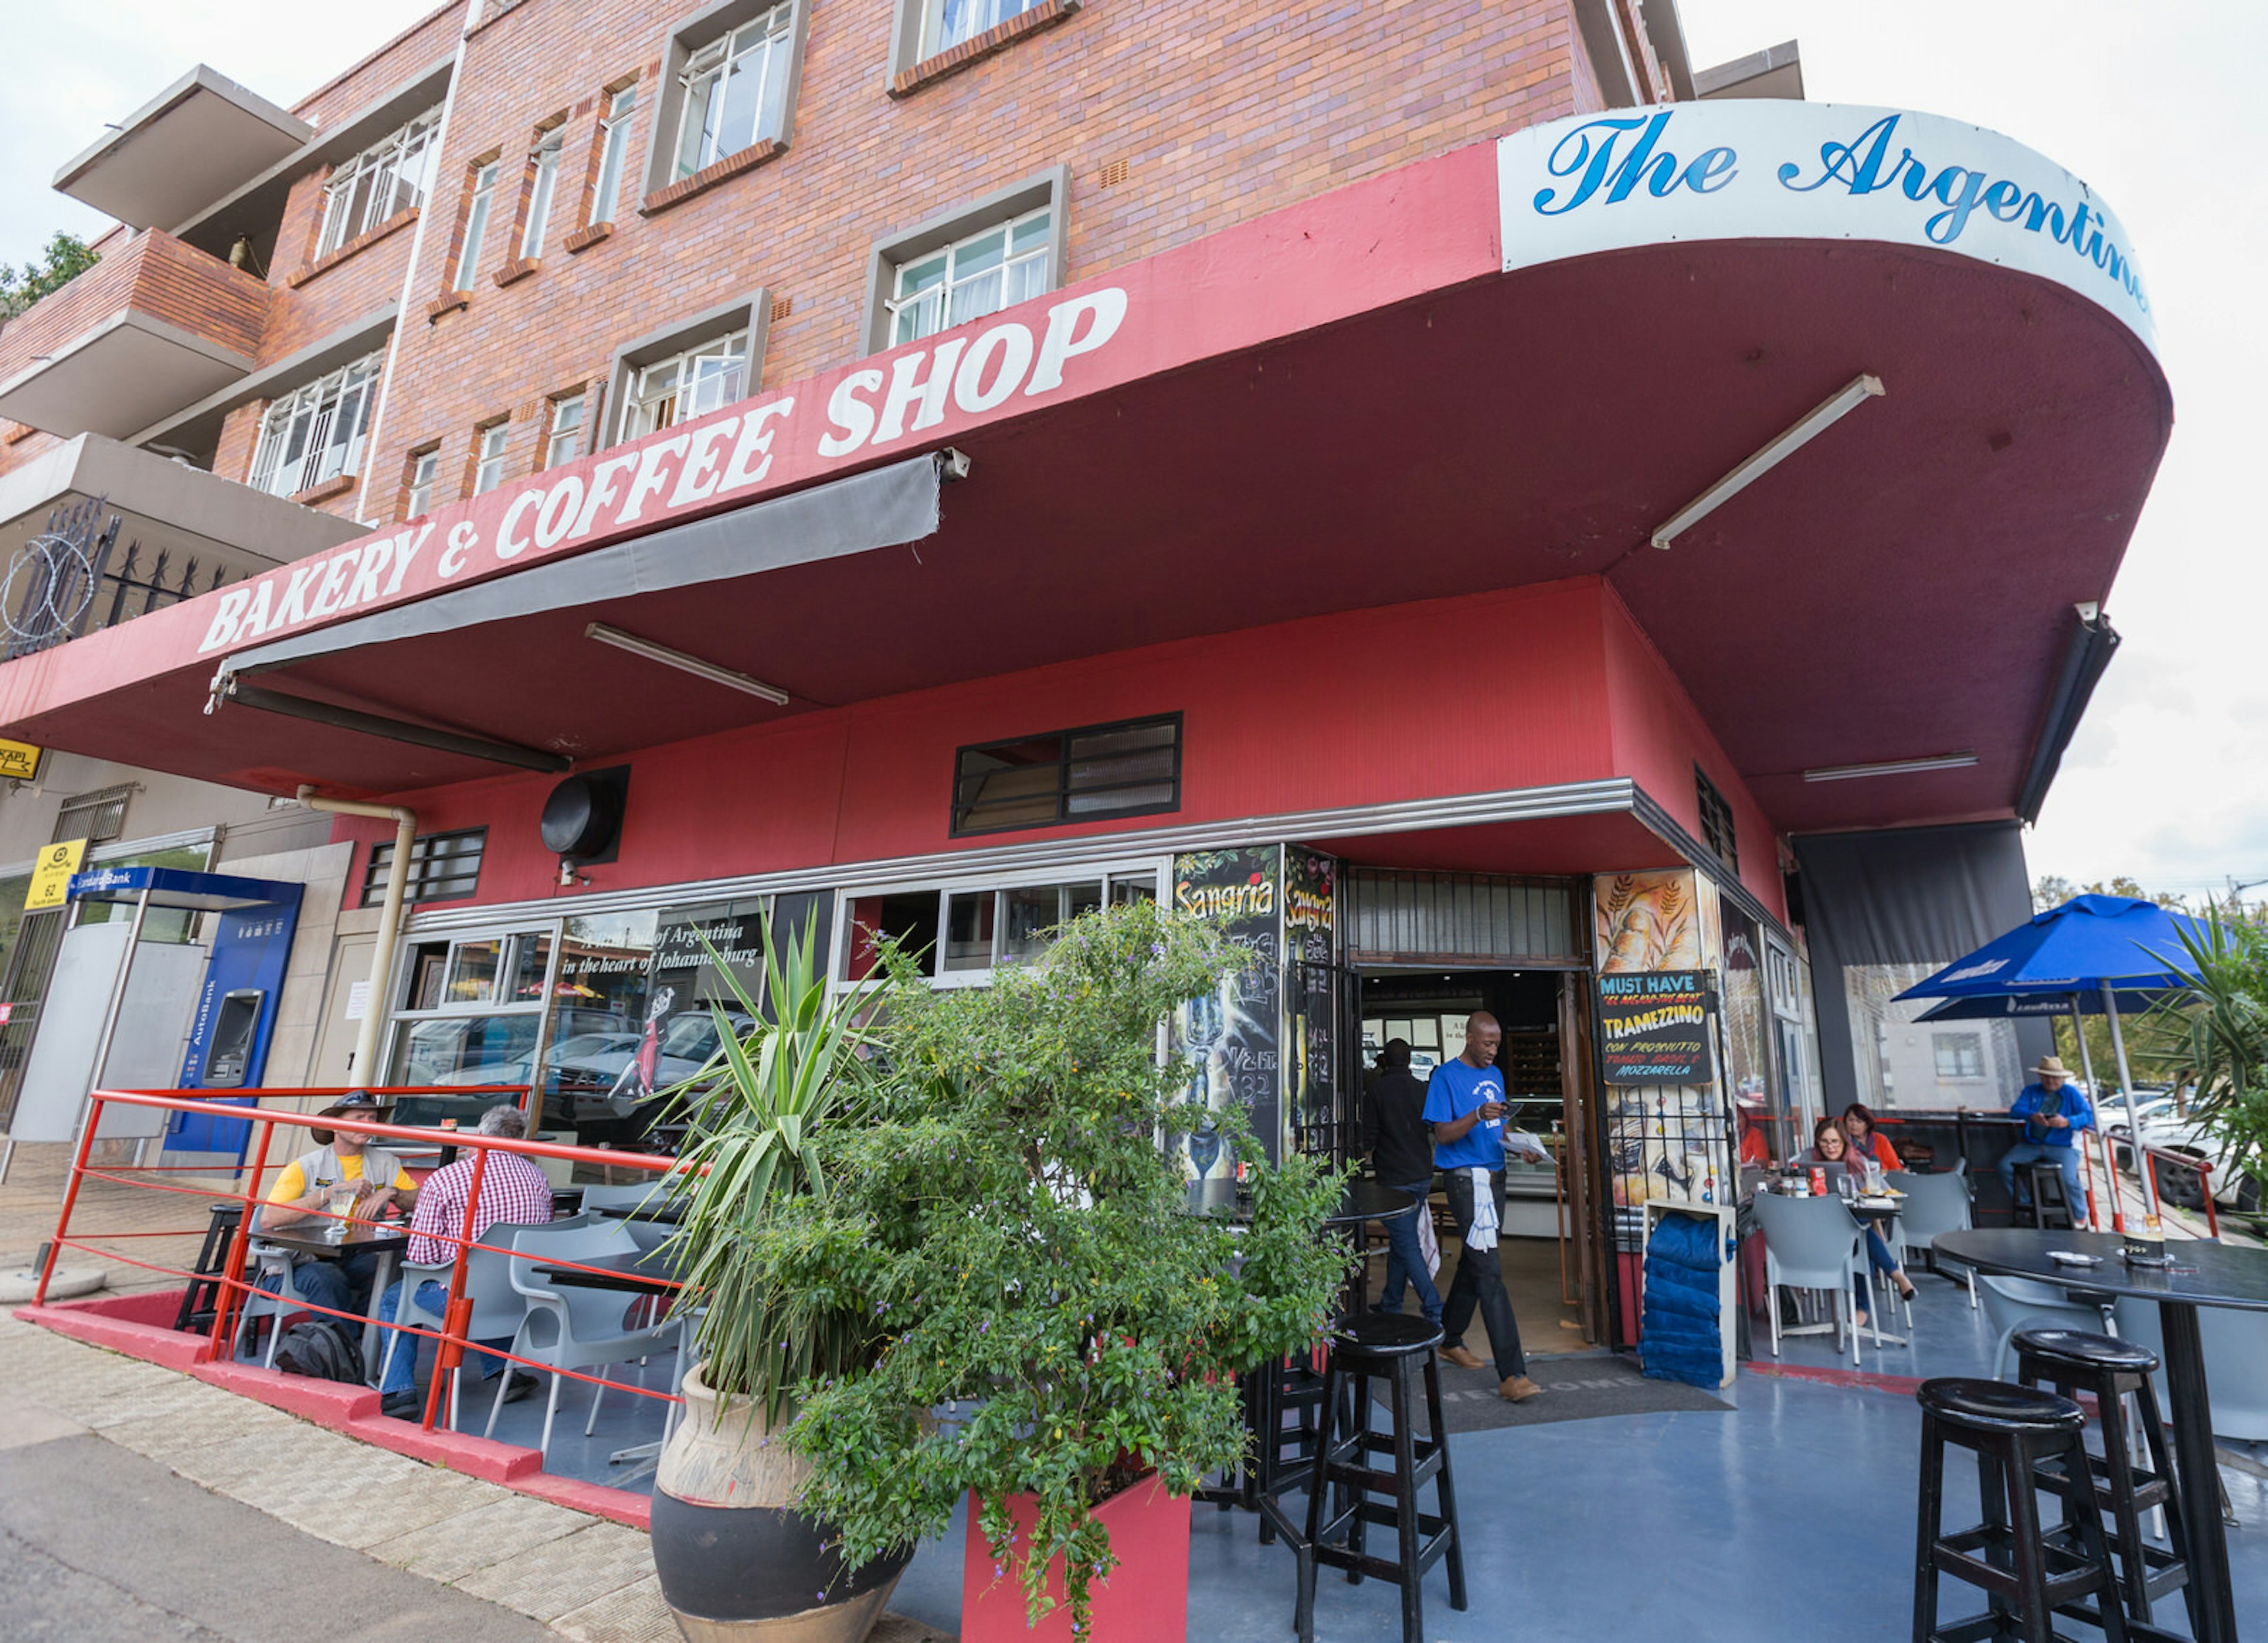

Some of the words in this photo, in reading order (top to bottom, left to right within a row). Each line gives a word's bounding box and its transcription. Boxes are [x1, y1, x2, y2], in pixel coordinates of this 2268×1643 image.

[1532, 109, 1739, 216] The
[197, 521, 436, 654] BAKERY
[437, 520, 478, 579] &
[494, 396, 796, 560] COFFEE
[817, 286, 1128, 458] SHOP
[106, 871, 131, 885] Bank
[1175, 872, 1275, 920] Sangria
[654, 926, 670, 951] of
[562, 960, 575, 974] in
[579, 956, 598, 974] the
[598, 954, 637, 973] heart
[639, 950, 656, 976] of
[1599, 977, 1644, 995] MUST
[1647, 975, 1695, 993] HAVE
[193, 979, 216, 1046] AutoBank
[1602, 1005, 1705, 1039] TRAMEZZINO
[1605, 1042, 1629, 1054] CON
[1630, 1041, 1702, 1053] PROSCIUTTO
[1615, 1064, 1691, 1078] MOZZARELLA
